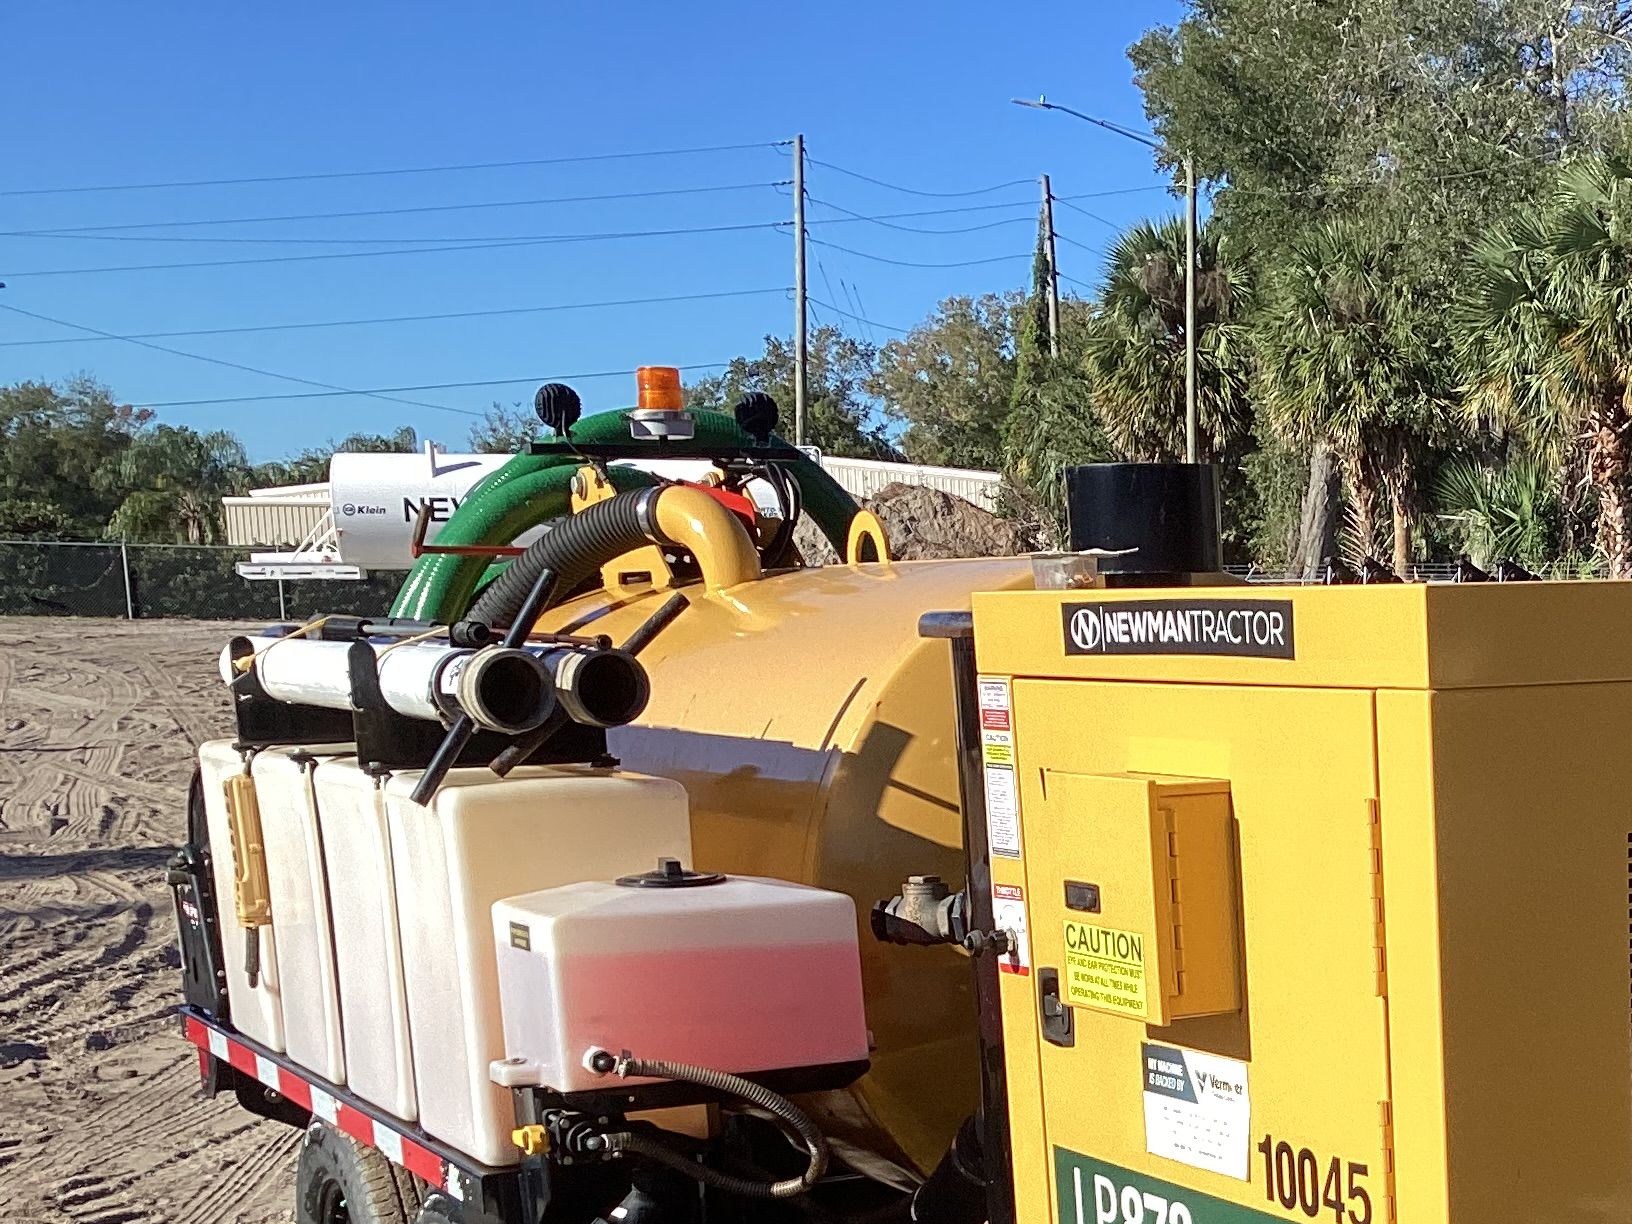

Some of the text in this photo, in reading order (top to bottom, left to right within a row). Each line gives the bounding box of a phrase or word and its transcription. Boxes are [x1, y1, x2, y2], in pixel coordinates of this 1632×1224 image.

[357, 506, 386, 515] Klein
[403, 497, 460, 522] NE
[1105, 610, 1285, 646] NEWMANTRACTOR
[1066, 924, 1142, 962] CAUTION
[1148, 1057, 1183, 1077] MY MACHINE
[1155, 1074, 1176, 1090] BACKED
[1177, 1079, 1185, 1092] BY
